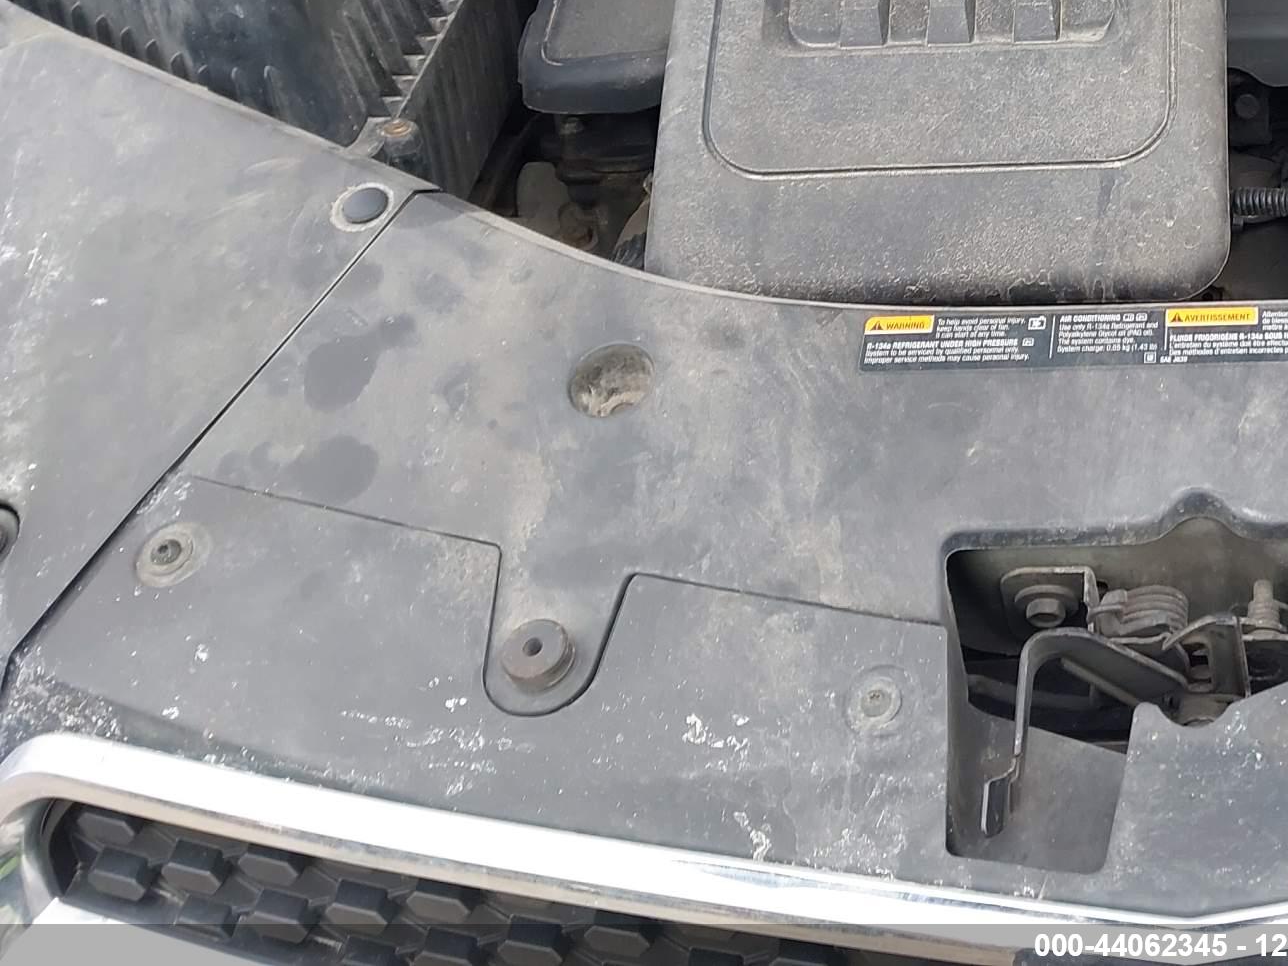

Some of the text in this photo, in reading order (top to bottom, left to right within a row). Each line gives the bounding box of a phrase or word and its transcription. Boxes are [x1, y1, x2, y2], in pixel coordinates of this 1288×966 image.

[1072, 314, 1121, 323] CONDITIONING
[1184, 313, 1250, 322] AVERTISSEMENT
[886, 321, 925, 330] WARNING
[866, 338, 1018, 350] R-134a REFRIGERANT UNDER HIGH PRESSURE
